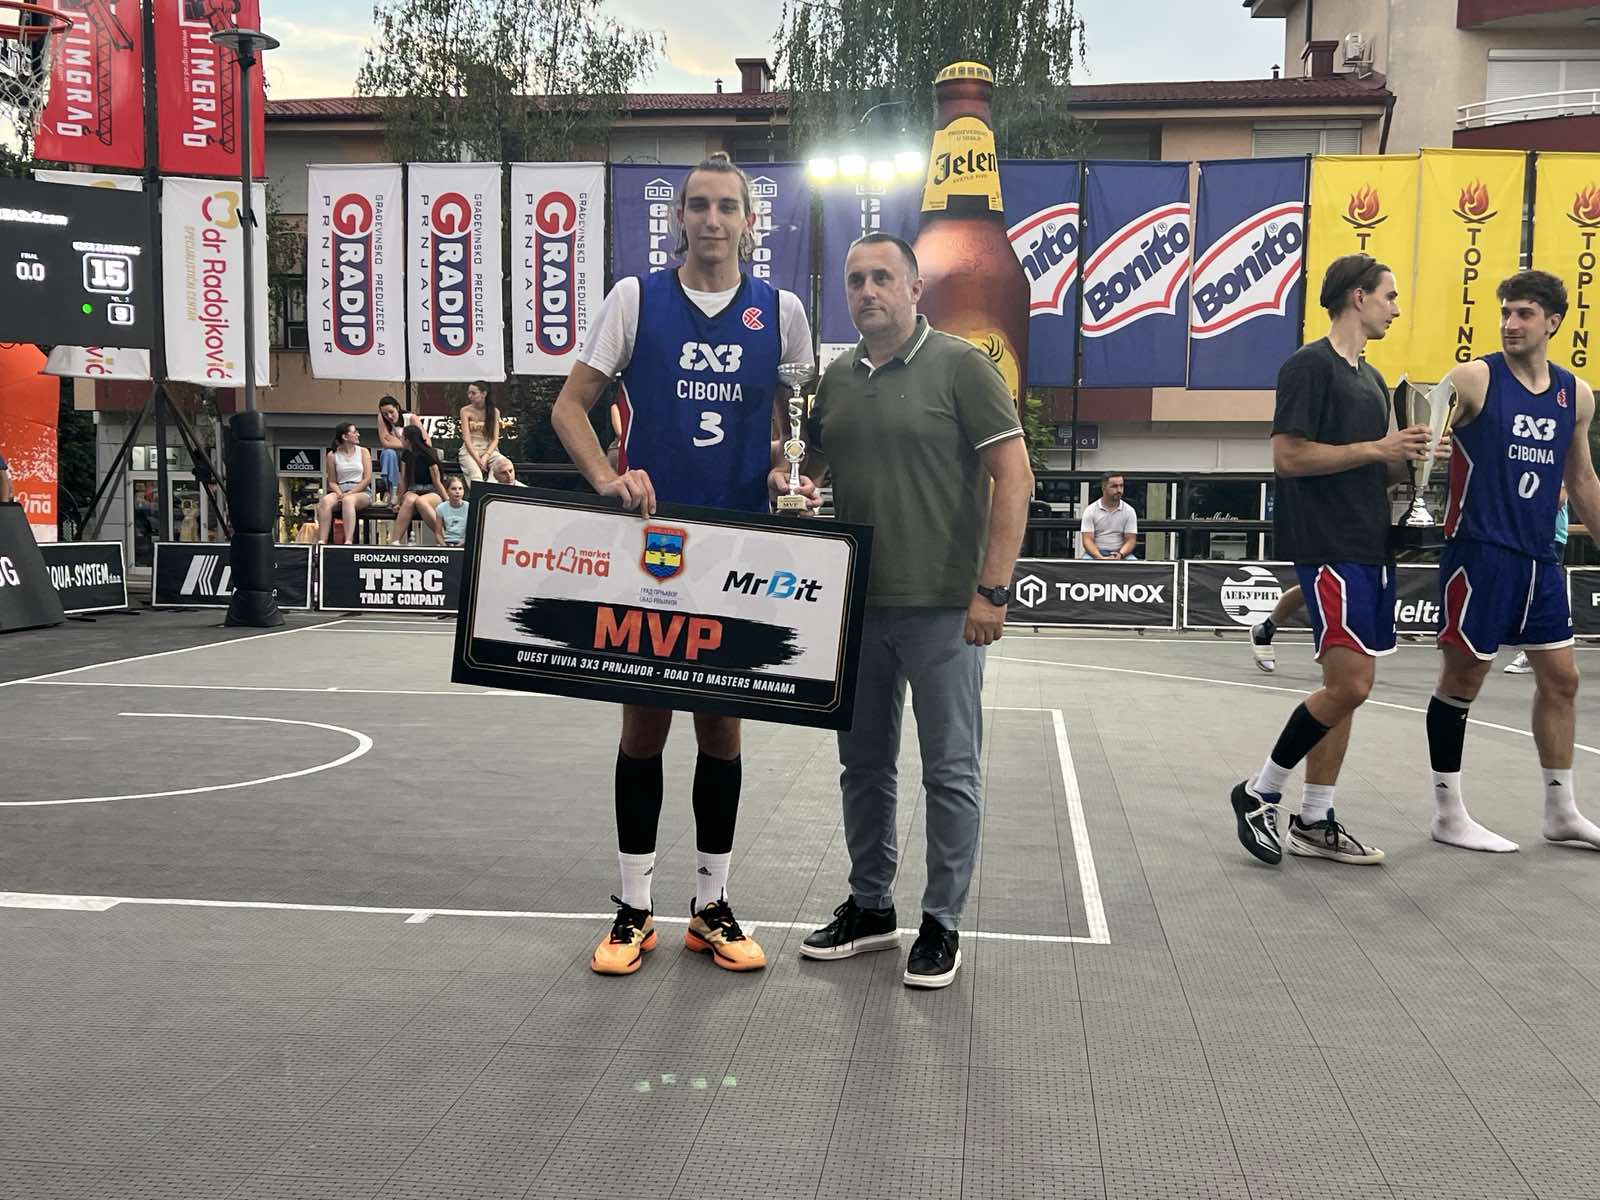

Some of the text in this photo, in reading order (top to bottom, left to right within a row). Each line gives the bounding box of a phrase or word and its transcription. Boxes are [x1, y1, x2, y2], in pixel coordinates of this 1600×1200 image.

[57, 21, 94, 137] TIMGRAD
[183, 32, 216, 148] TIMGRAD
[934, 149, 997, 186] Jelen
[90, 259, 126, 287] 15
[321, 195, 333, 353] PRNJAVOR
[333, 193, 373, 347] GRADIP
[420, 194, 431, 354] PRNJAVOR
[431, 192, 472, 347] GRADIP
[524, 193, 534, 354] PRNJAVOR
[535, 191, 577, 347] GRADIP
[1022, 222, 1079, 281] nito
[1083, 222, 1190, 322] Bonito
[1192, 222, 1302, 323] Bonito
[199, 228, 235, 378] dr Radojković
[1455, 228, 1481, 363] TOPLING
[1571, 232, 1596, 368] TOPLING
[377, 342, 386, 356] AD
[476, 342, 485, 356] AD
[676, 379, 744, 401] CIBONA
[693, 411, 725, 447] 3
[1508, 444, 1555, 465] CIBONA
[1518, 471, 1540, 499] 0
[353, 554, 449, 564] BRONZANI SPONZORI
[579, 549, 611, 559] market
[46, 563, 109, 591] QUA-SYSTEM
[359, 568, 443, 592] TERC
[360, 592, 446, 606] TRADE COMPANY
[722, 570, 823, 602] MrBit
[1055, 583, 1165, 603] TOPINOX
[594, 606, 723, 660] MVP
[516, 650, 549, 664] QUEST
[551, 654, 577, 668] VIVIA
[580, 658, 600, 670] 3X3
[602, 661, 654, 677] PRNJAVOR
[663, 668, 689, 681] ROAD
[692, 671, 704, 683] TO
[706, 673, 751, 689] MASTERS
[752, 679, 796, 695] MANAMA
